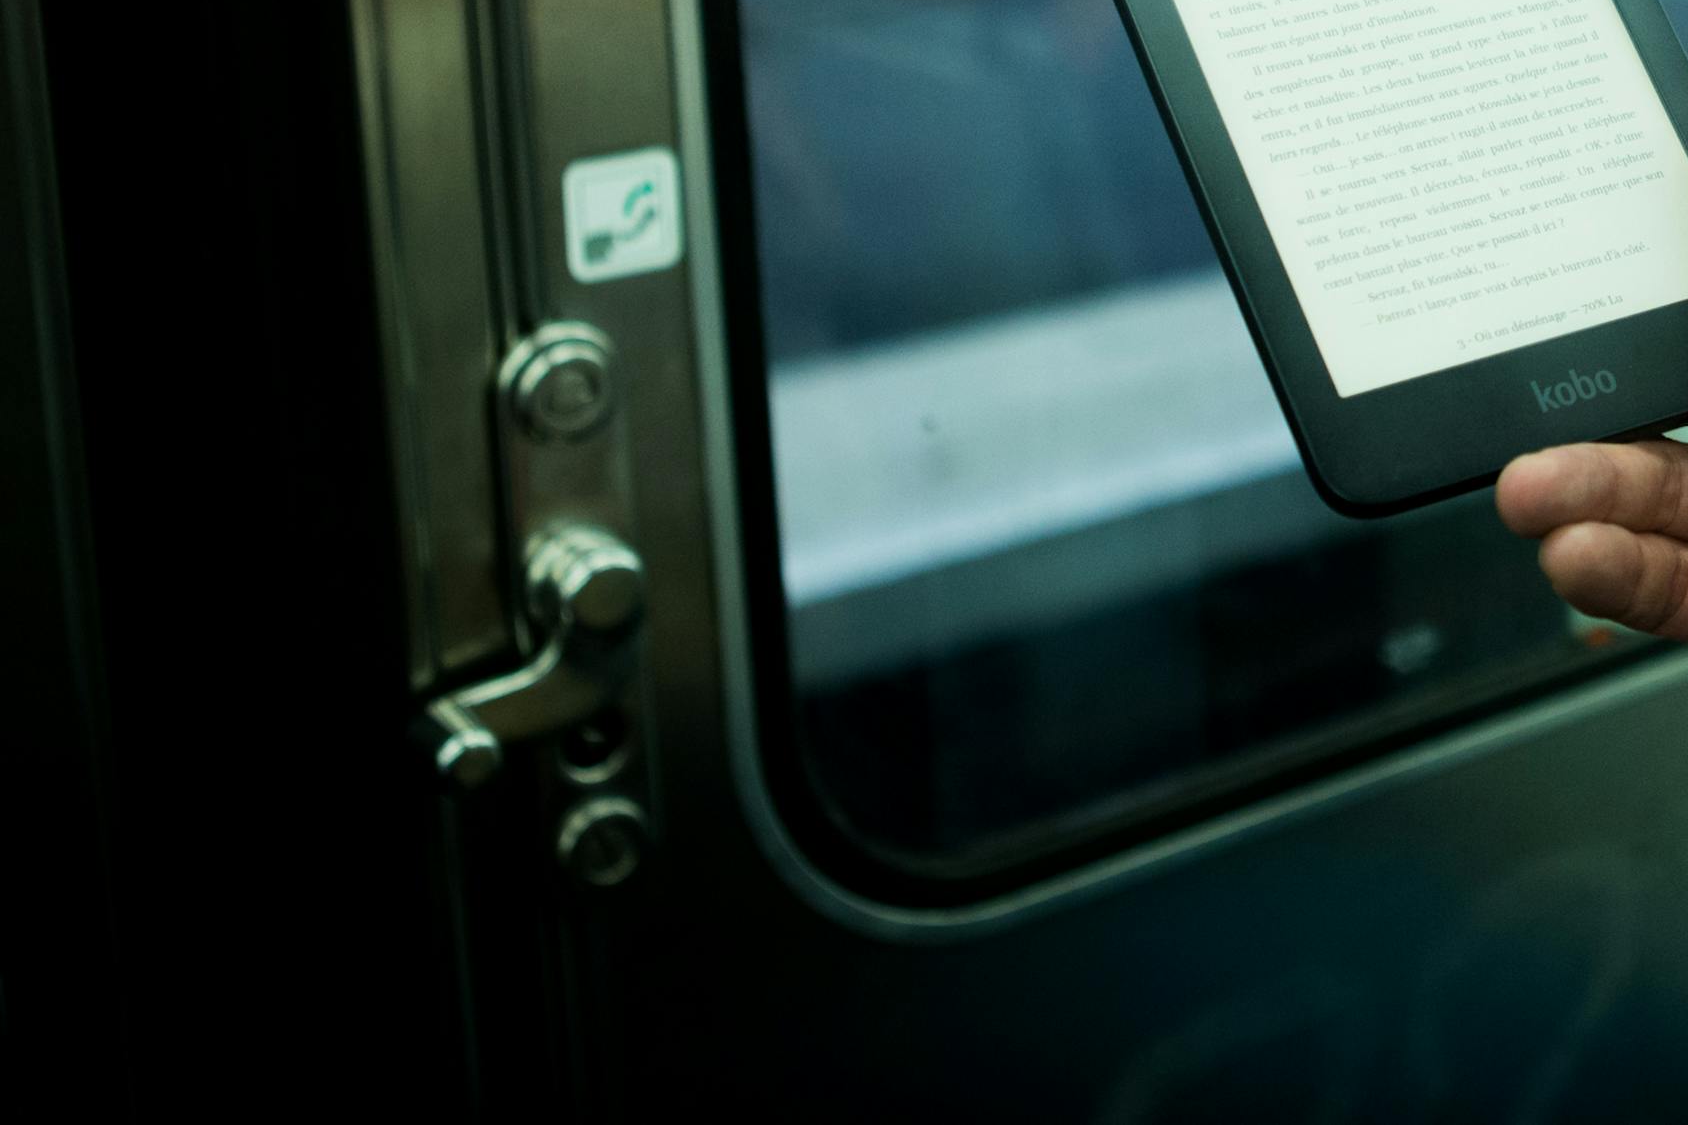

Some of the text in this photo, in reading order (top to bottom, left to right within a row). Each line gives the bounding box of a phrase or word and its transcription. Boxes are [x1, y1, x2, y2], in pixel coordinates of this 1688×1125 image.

[1217, 21, 1267, 39] balancer
[1271, 17, 1288, 27] les
[1292, 8, 1328, 23] autres
[1331, 1, 1360, 14] dans
[1226, 21, 1363, 59] comme égout jour
[1228, 1, 1266, 15] tiroirs,
[1253, 65, 1262, 76] Il
[1266, 57, 1303, 73] trouva
[1307, 43, 1357, 63] Kowalski
[1361, 41, 1375, 51] en
[1380, 32, 1414, 49] pleine
[1417, 16, 1486, 38] conversation
[1490, 9, 1513, 21] avec
[1242, 88, 1263, 100] des
[1269, 72, 1333, 94] enquêteurs
[1337, 67, 1354, 78] du
[1360, 57, 1403, 76] groupe,
[1408, 51, 1424, 62] un
[1429, 41, 1462, 60] grand
[1467, 36, 1492, 50] type
[1496, 26, 1535, 41] chauve
[1252, 30, 1598, 121] sèche et maladive. Les deux hommes levèrent la tête quand il
[1260, 51, 1607, 141] entra, et il fut immédiatement aux aguets. Quelque chose dans
[1268, 75, 1603, 162] leurs Le téléphone sonna et Kowalski se jeta dessus.
[1337, 109, 1635, 192] tourna vers Servaz, allait parler quand téléphone
[1415, 95, 1608, 149] arrive rugit-il avant raccrocher.
[1296, 210, 1331, 226] sonna
[1354, 192, 1407, 211] nouveau.
[1422, 173, 1478, 193] décrocha,
[1480, 162, 1522, 178] écouta,
[1525, 147, 1571, 167] répondit
[1306, 149, 1654, 247] voix forte, reposa violemment combiné. téléphone
[1314, 169, 1663, 272] grelotta dans bureau voisin. Servaz rendit compte que son
[1323, 218, 1556, 290] cœur battait plus vite. Que passait-il ici
[1367, 263, 1482, 302] Servaz, fit Kowalski,
[1376, 240, 1649, 324] Patron lança une voix depuis bureau côté.
[1473, 293, 1622, 343] Où on déménage 70% Lu
[1530, 368, 1617, 414] kobo
